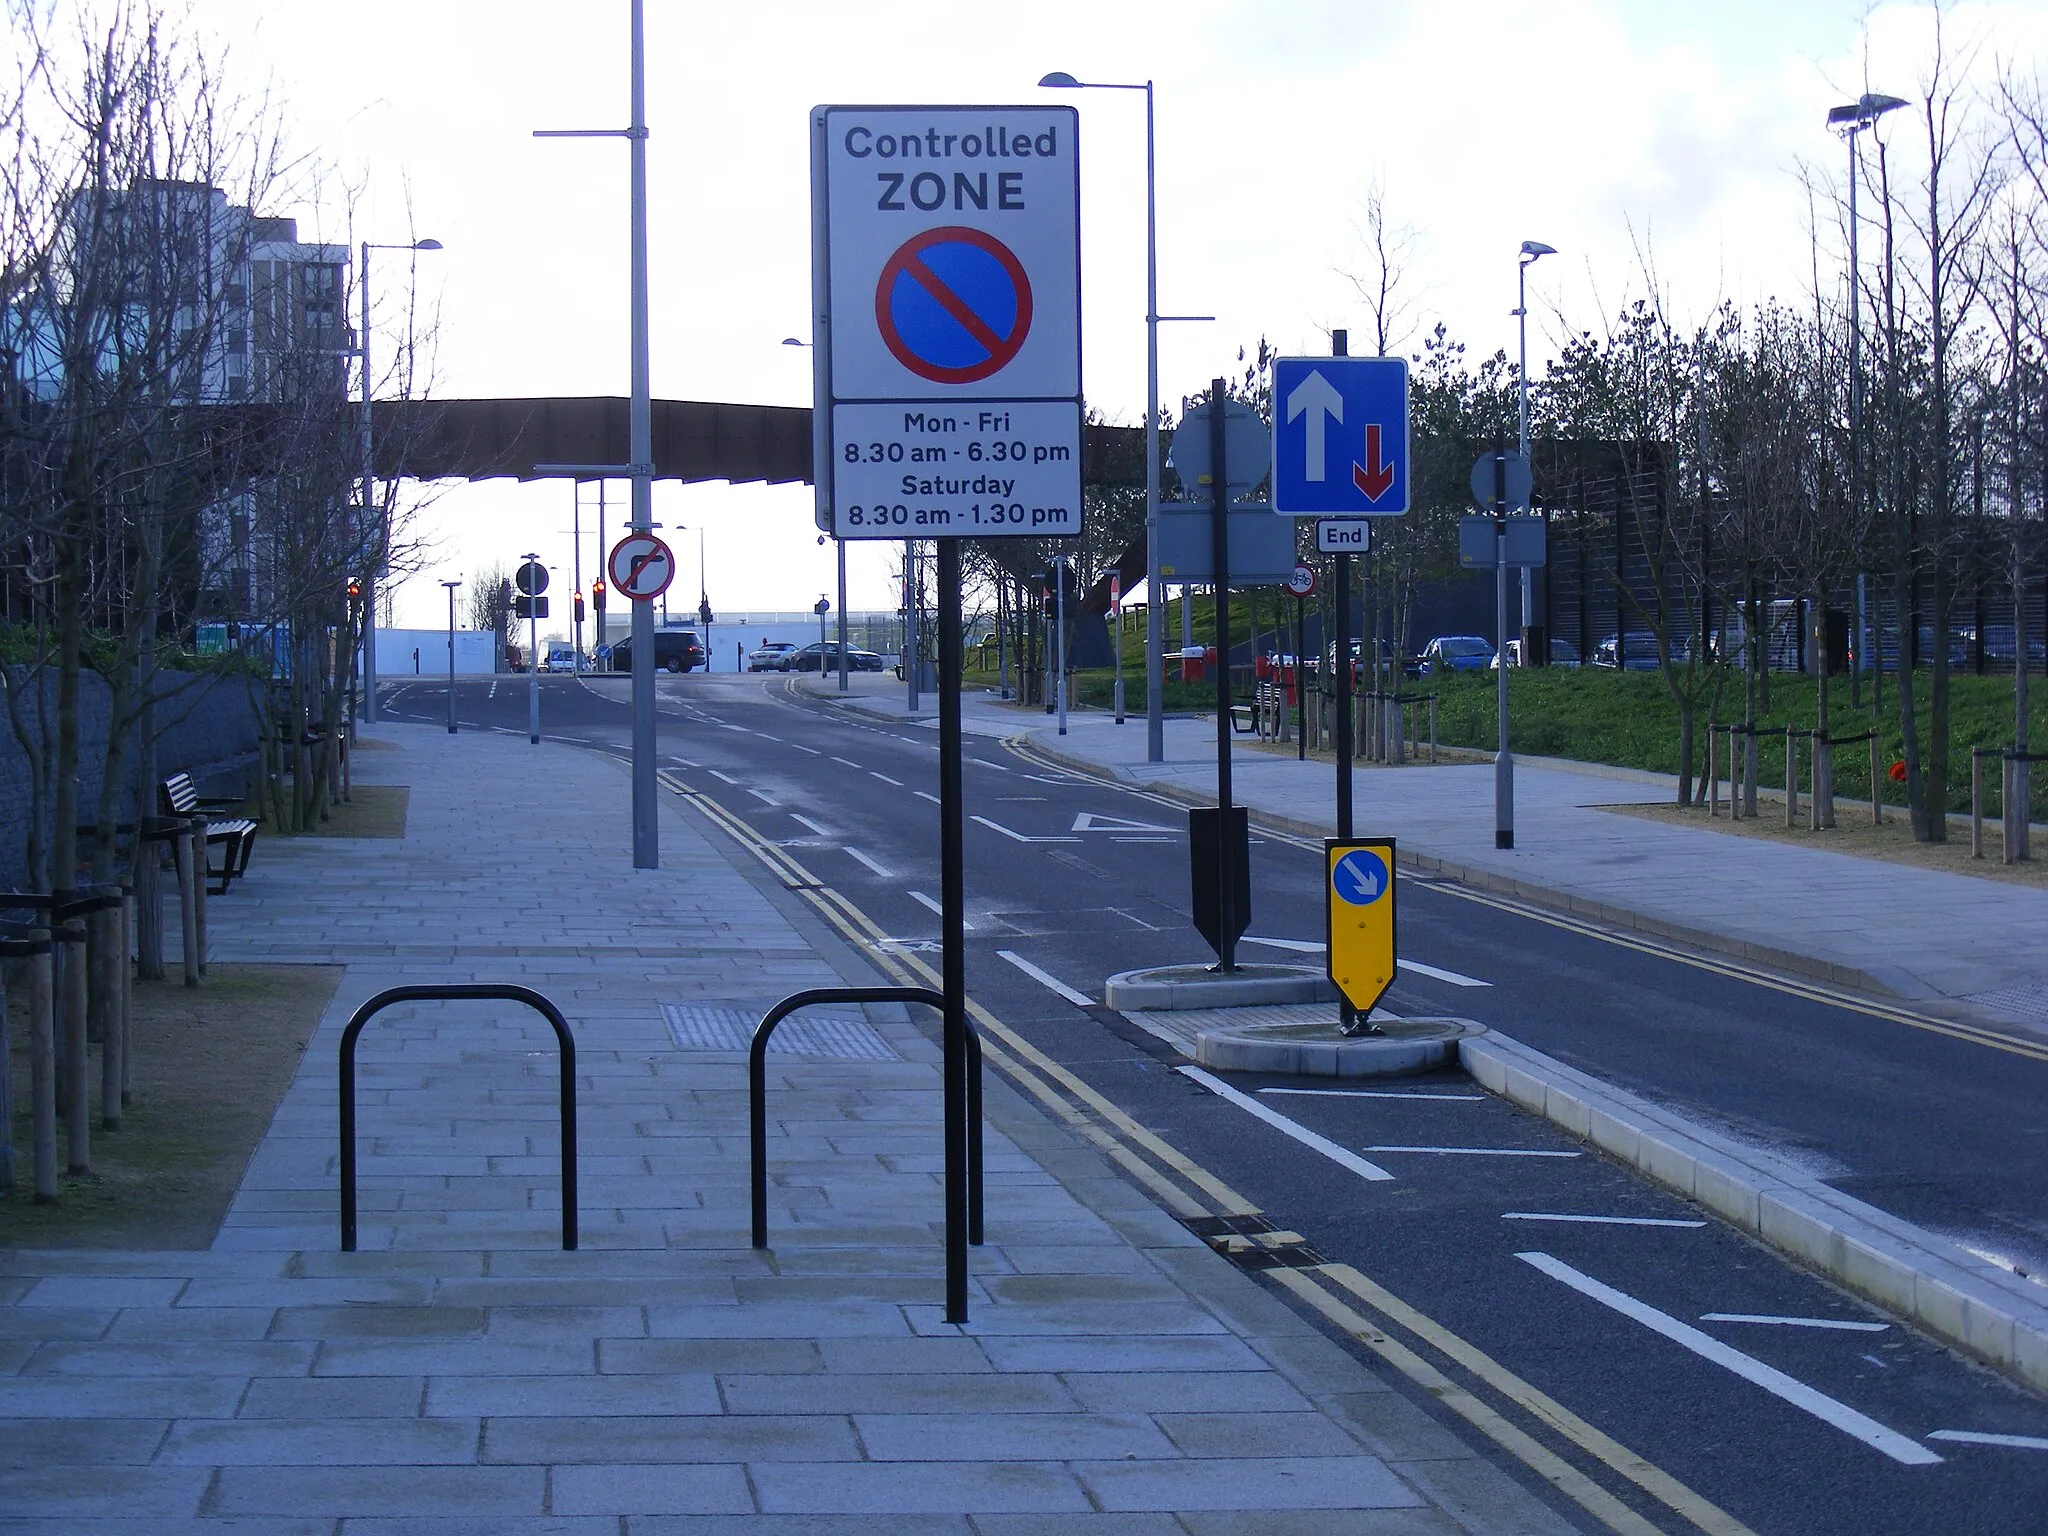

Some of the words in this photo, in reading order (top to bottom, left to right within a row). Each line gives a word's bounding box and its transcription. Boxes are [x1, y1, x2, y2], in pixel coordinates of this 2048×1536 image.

[845, 126, 1057, 158] Controlled
[877, 172, 1025, 211] ZONE
[904, 413, 956, 433] Mon
[979, 412, 1010, 432] Fri
[844, 442, 904, 464] 8.30
[910, 447, 947, 463] am
[967, 441, 1027, 462] 6.30
[1033, 445, 1070, 465] pm
[900, 474, 1016, 498] Saturday
[848, 504, 908, 526] 8.30
[915, 509, 951, 525] am
[971, 503, 1025, 525] 1.30
[1032, 508, 1068, 527] pm
[1327, 527, 1362, 544] End
